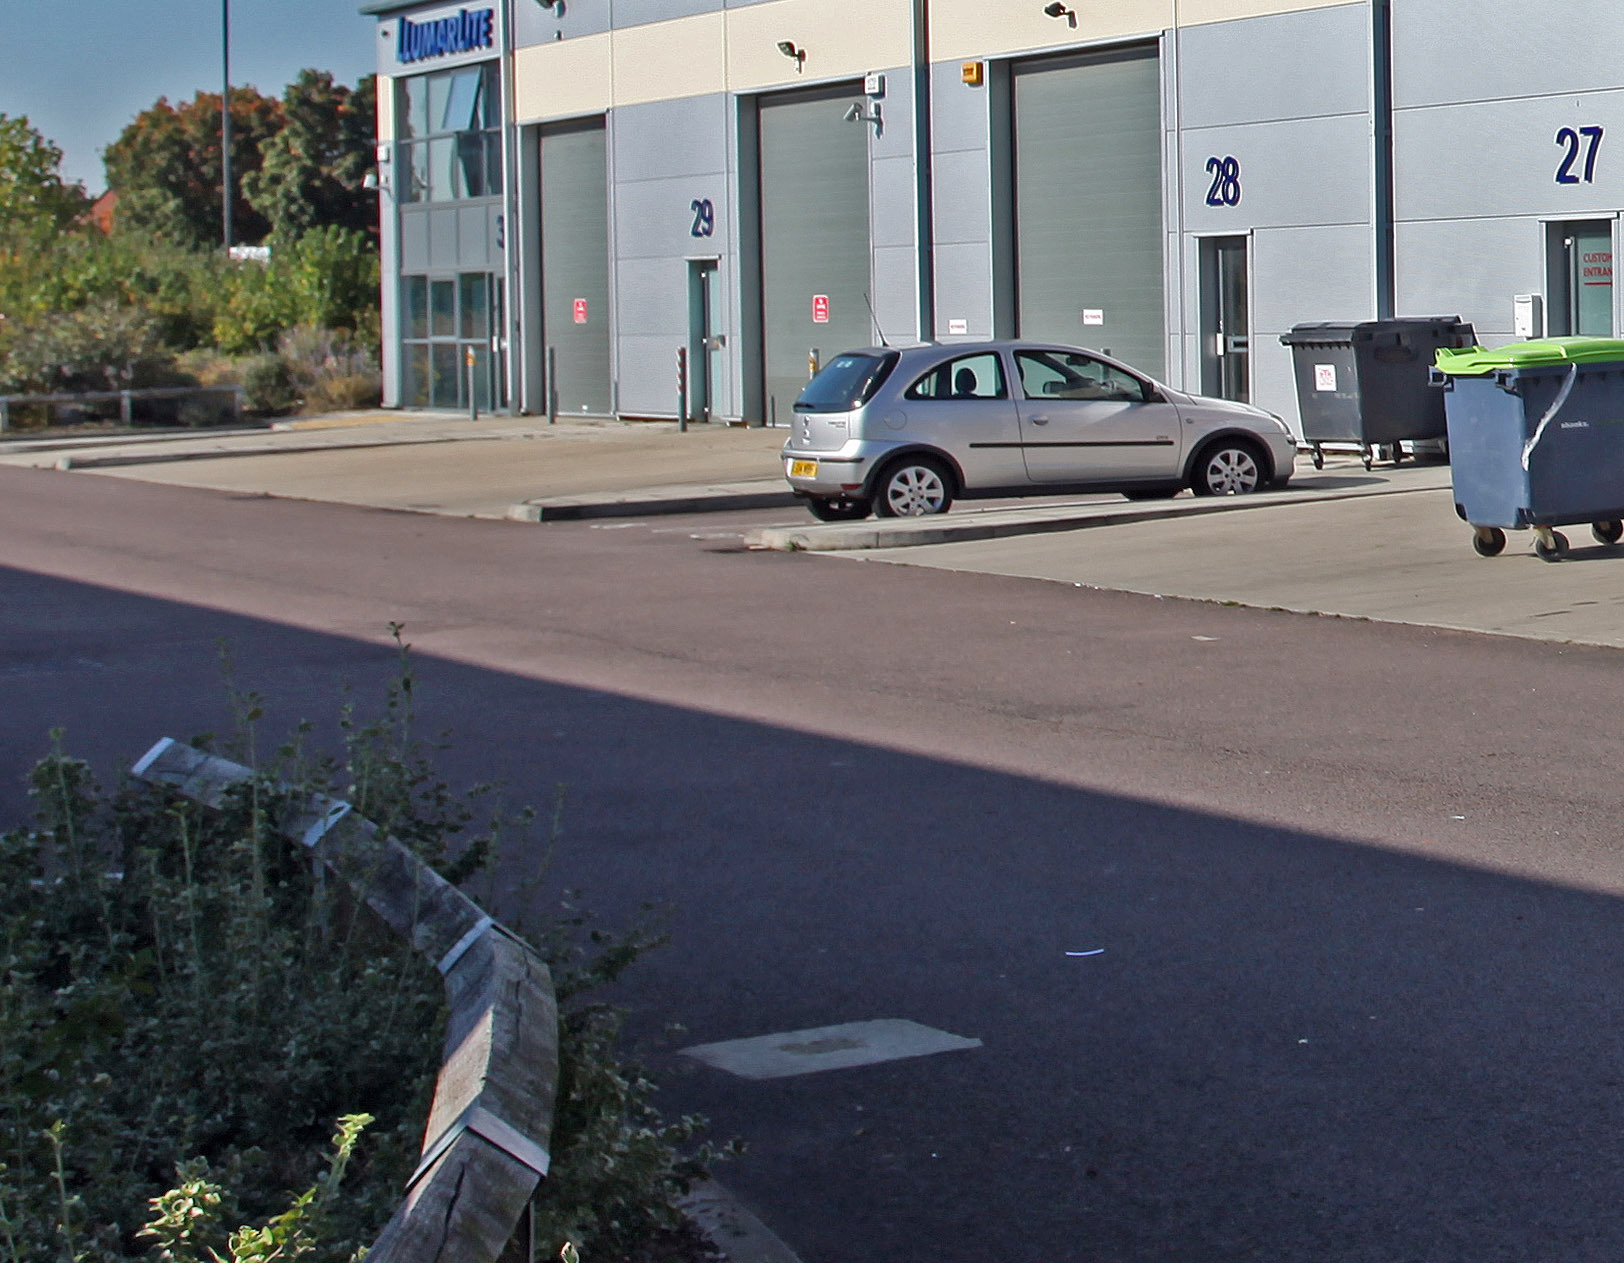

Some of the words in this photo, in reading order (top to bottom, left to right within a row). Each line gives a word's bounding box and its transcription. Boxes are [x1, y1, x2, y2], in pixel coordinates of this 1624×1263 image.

[1555, 125, 1604, 184] 27
[1206, 156, 1240, 206] 28
[691, 199, 713, 237] 29
